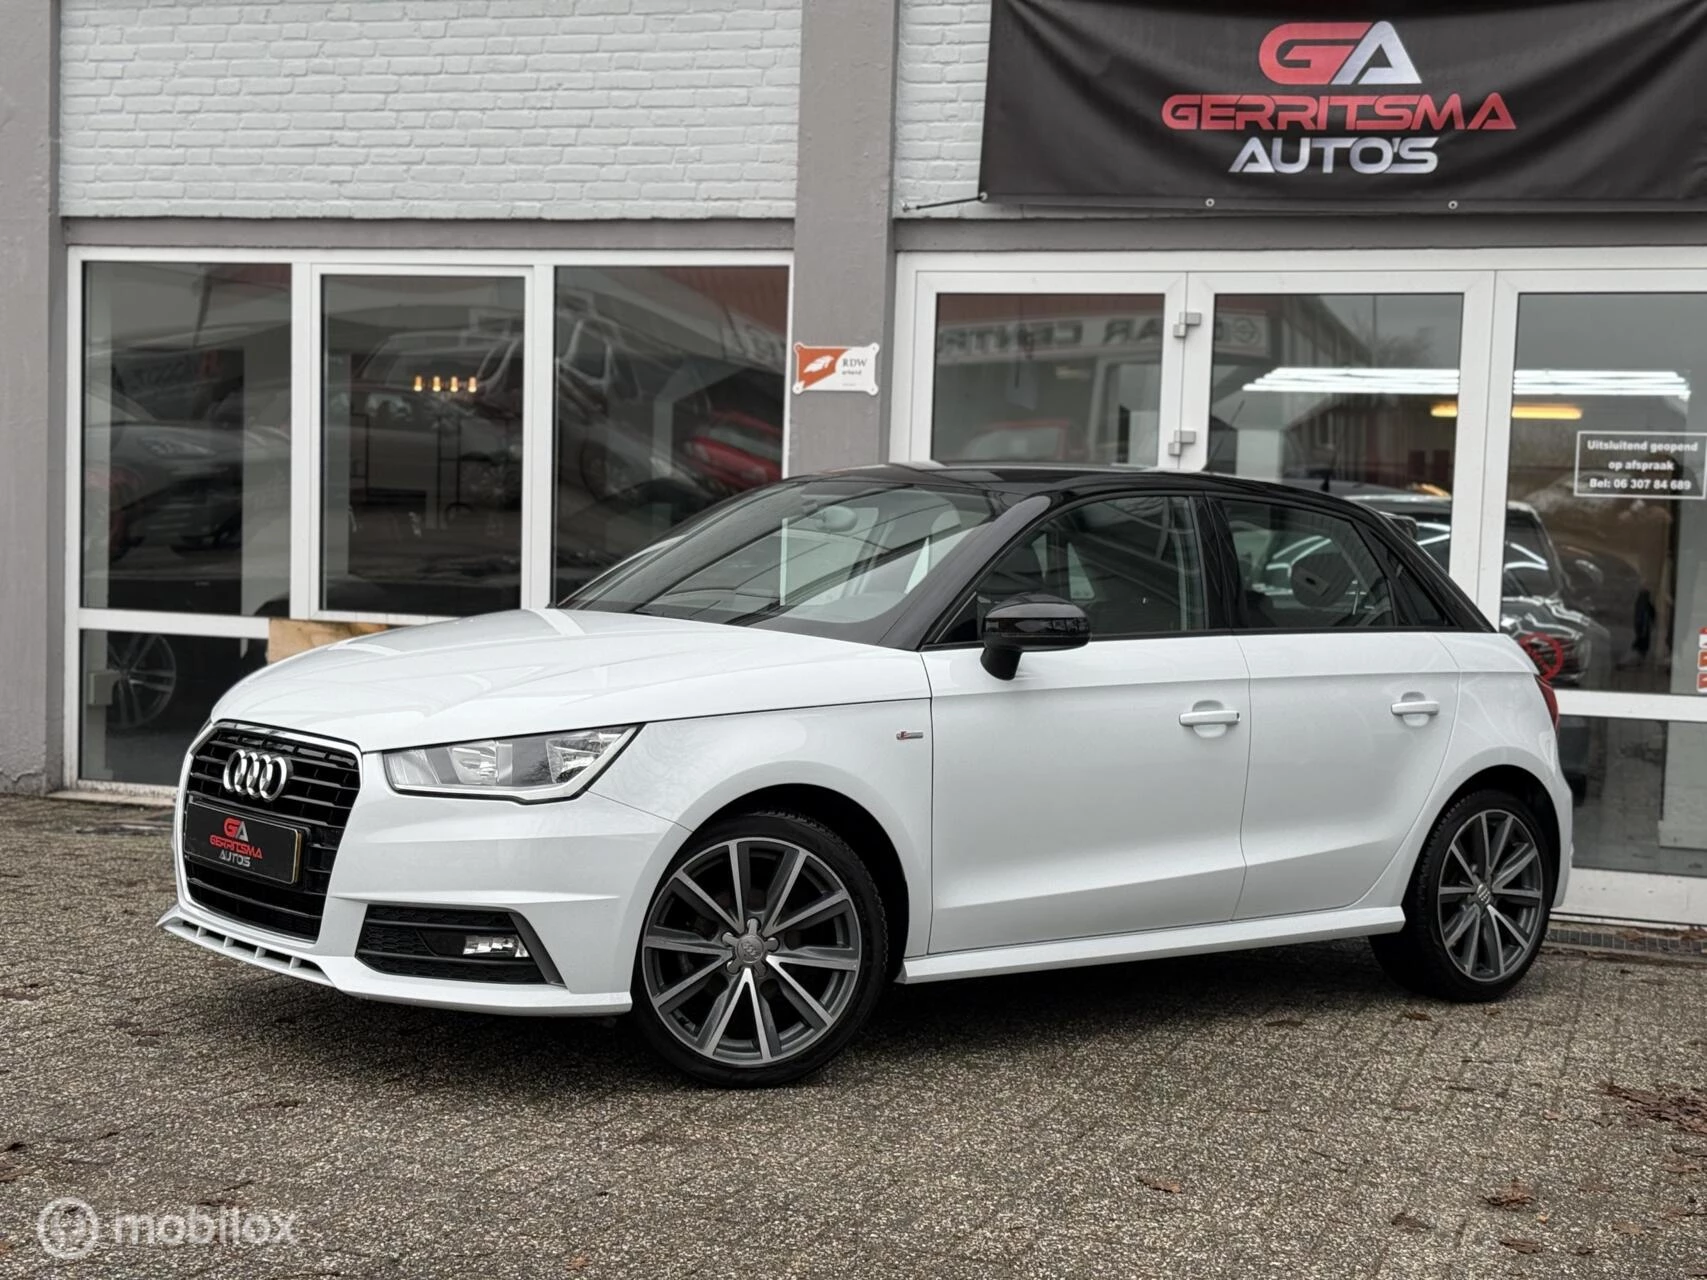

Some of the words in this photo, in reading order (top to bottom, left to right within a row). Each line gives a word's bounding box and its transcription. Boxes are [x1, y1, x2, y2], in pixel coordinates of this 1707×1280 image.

[1258, 20, 1422, 85] GA
[1161, 91, 1517, 130] GERRITSMA
[1228, 136, 1439, 174] AUTO'S
[842, 358, 868, 367] RDW
[1587, 440, 1648, 451] Uitsluitend
[1650, 441, 1699, 453] geopend
[1608, 461, 1622, 471] op
[1625, 460, 1675, 471] afspraak
[1589, 478, 1611, 489] Bel:
[1613, 479, 1628, 489] 06
[1630, 479, 1652, 490] 307
[1653, 479, 1668, 490] 84
[1670, 480, 1692, 490] 689
[224, 817, 249, 842] GA
[209, 834, 263, 859] GERRITSMA
